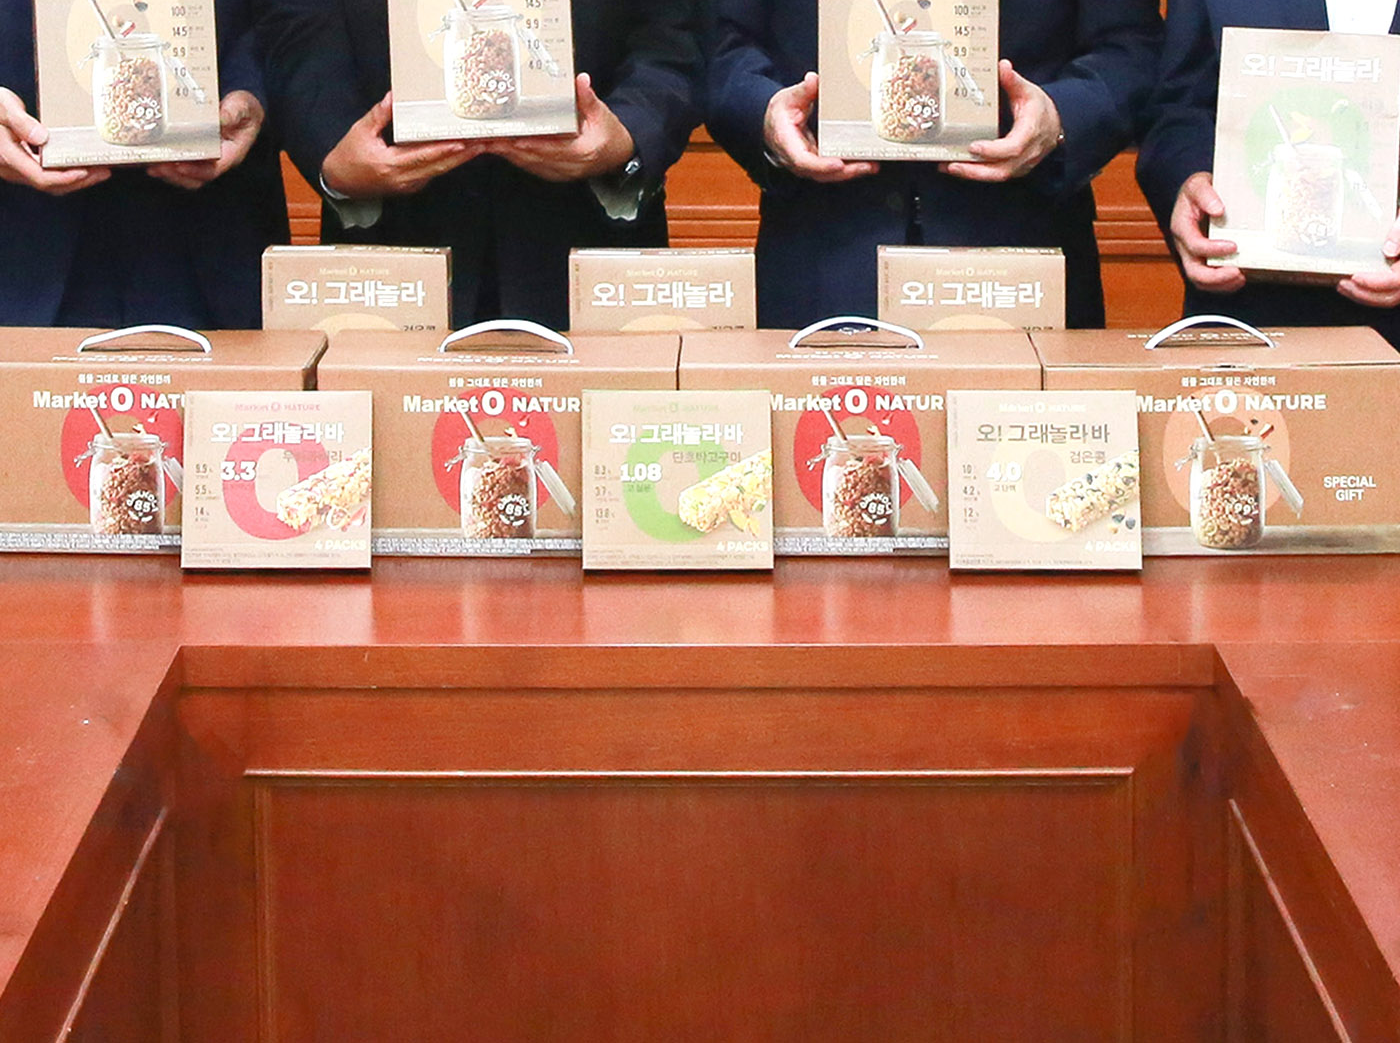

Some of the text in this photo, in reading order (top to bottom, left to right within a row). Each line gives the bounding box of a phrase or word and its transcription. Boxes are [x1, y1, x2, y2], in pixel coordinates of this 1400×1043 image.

[1241, 53, 1382, 83] 오! 그래놀라
[284, 279, 426, 307] 오! 그래놀라
[591, 280, 734, 308] 오! 그래놀라
[900, 281, 1044, 308] 오! 그래놀라
[33, 391, 107, 409] Market
[110, 386, 134, 411] O
[403, 395, 478, 413] Market
[481, 390, 505, 415] O
[770, 394, 841, 411] Market
[844, 388, 868, 414] O
[1136, 389, 1327, 414] Market O NATURE
[210, 422, 238, 442] 오!
[609, 423, 636, 443] 오!
[977, 424, 1002, 442] 오!
[1070, 451, 1106, 464] 검은콩
[220, 461, 257, 481] 3.3
[620, 463, 662, 482] 1.08
[986, 462, 1022, 482] 4.0
[1324, 476, 1376, 488] SPECIAL
[1335, 489, 1365, 501] GIFT
[314, 540, 324, 550] 4
[324, 540, 367, 550] PACKS
[716, 541, 726, 551] 4
[727, 541, 769, 552] PACKS
[1085, 541, 1137, 552] 4 PACKS
